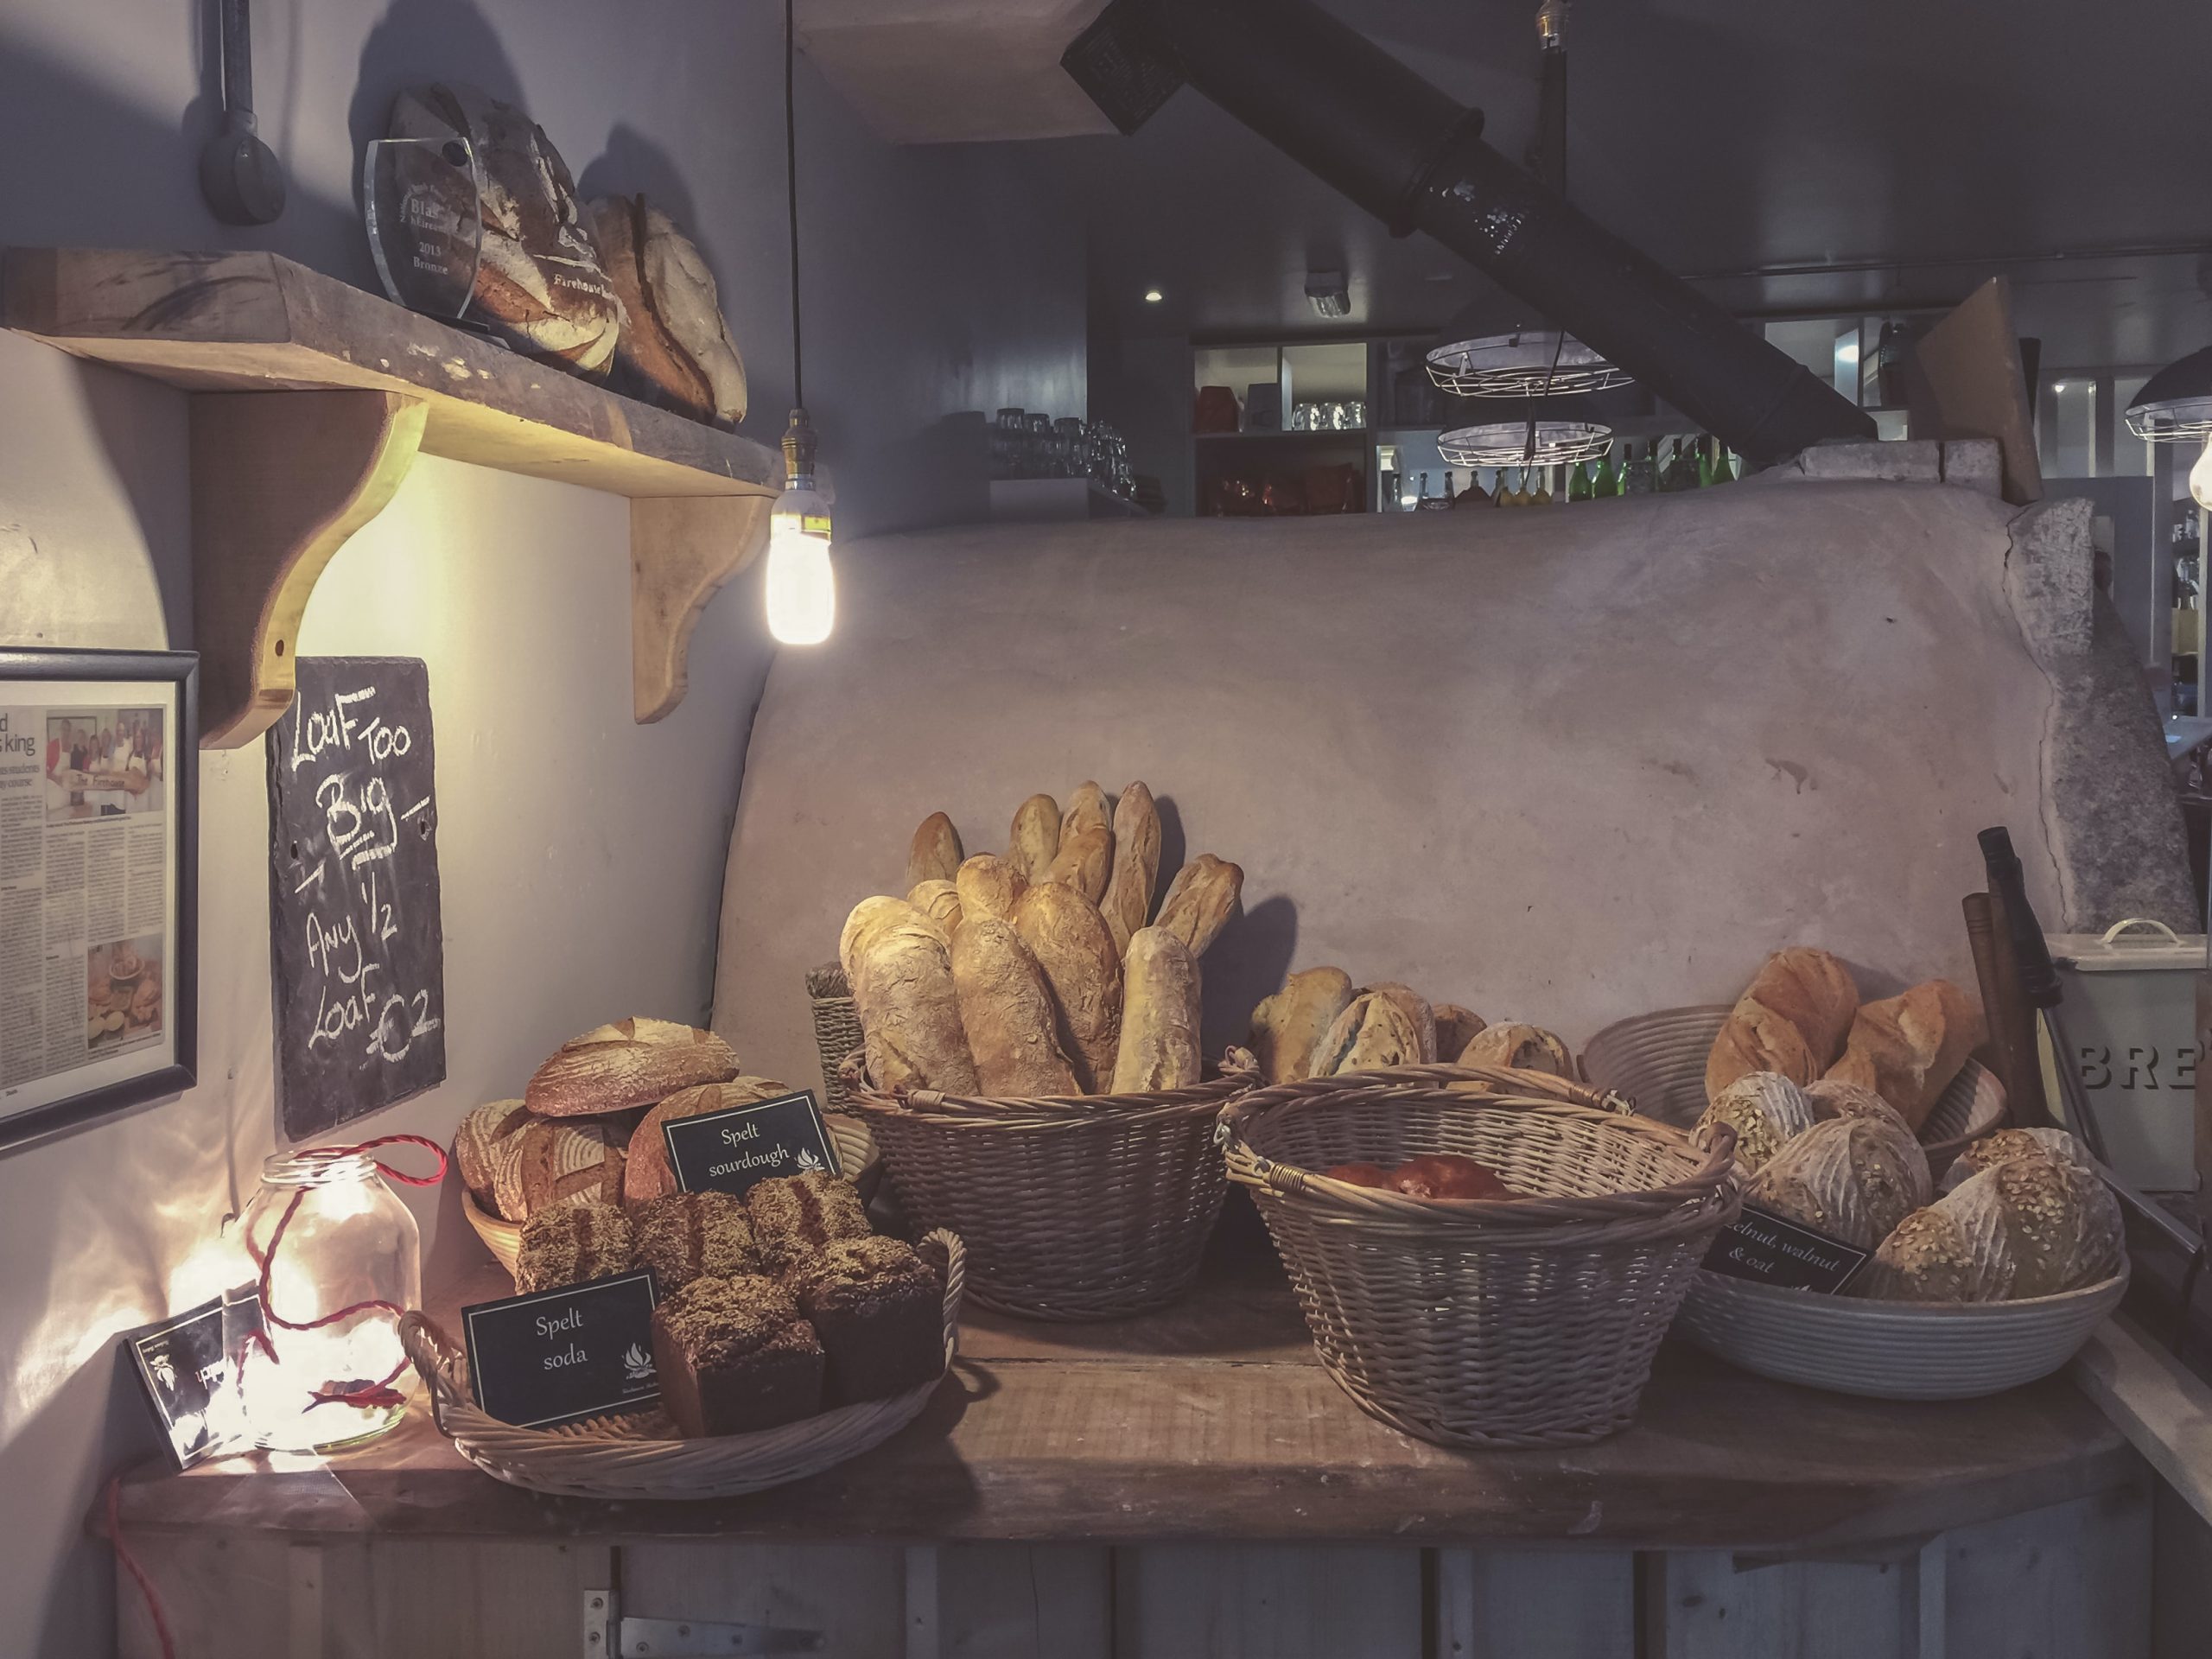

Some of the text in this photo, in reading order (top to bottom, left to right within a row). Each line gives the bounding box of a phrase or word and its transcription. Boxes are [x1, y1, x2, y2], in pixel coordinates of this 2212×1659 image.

[419, 241, 442, 257] 2013
[413, 256, 448, 275] Bronze
[5, 733, 35, 757] king
[365, 988, 442, 1063] €2
[2081, 1045, 2196, 1090] BRE
[721, 1122, 760, 1147] Spelt
[709, 1143, 790, 1177] sourdough
[1725, 1221, 1841, 1273] elnut, walnut
[1729, 1247, 1777, 1274] & oat
[536, 1307, 584, 1340] Spelt
[543, 1343, 588, 1370] soda
